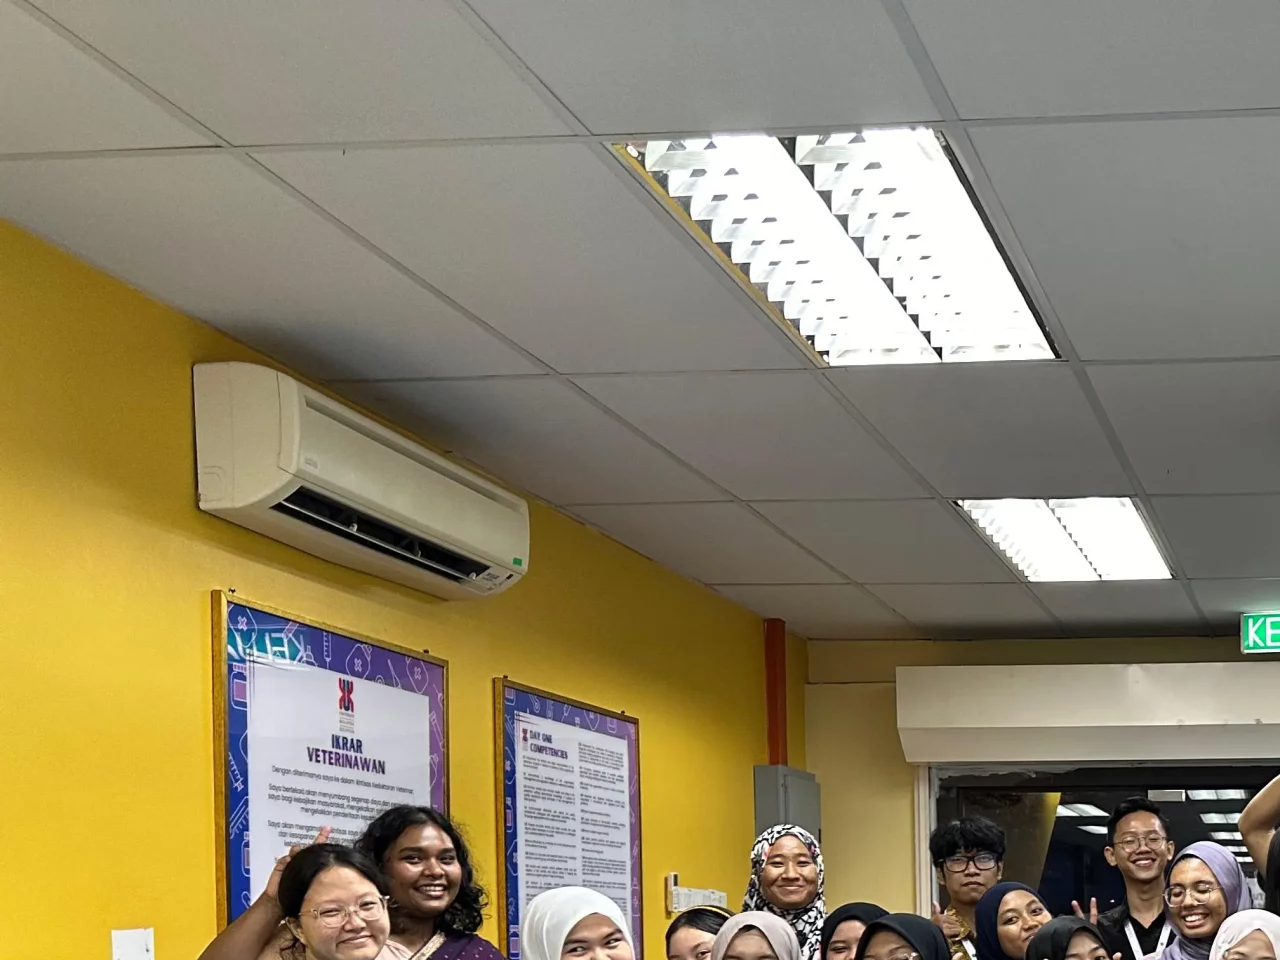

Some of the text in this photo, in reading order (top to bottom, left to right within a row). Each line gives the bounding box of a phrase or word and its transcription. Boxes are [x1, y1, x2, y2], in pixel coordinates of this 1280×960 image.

[331, 734, 363, 754] IKRAR
[542, 732, 553, 744] ONE
[307, 746, 386, 775] VETERINAWAN
[530, 743, 568, 760] COMPETENCIES
